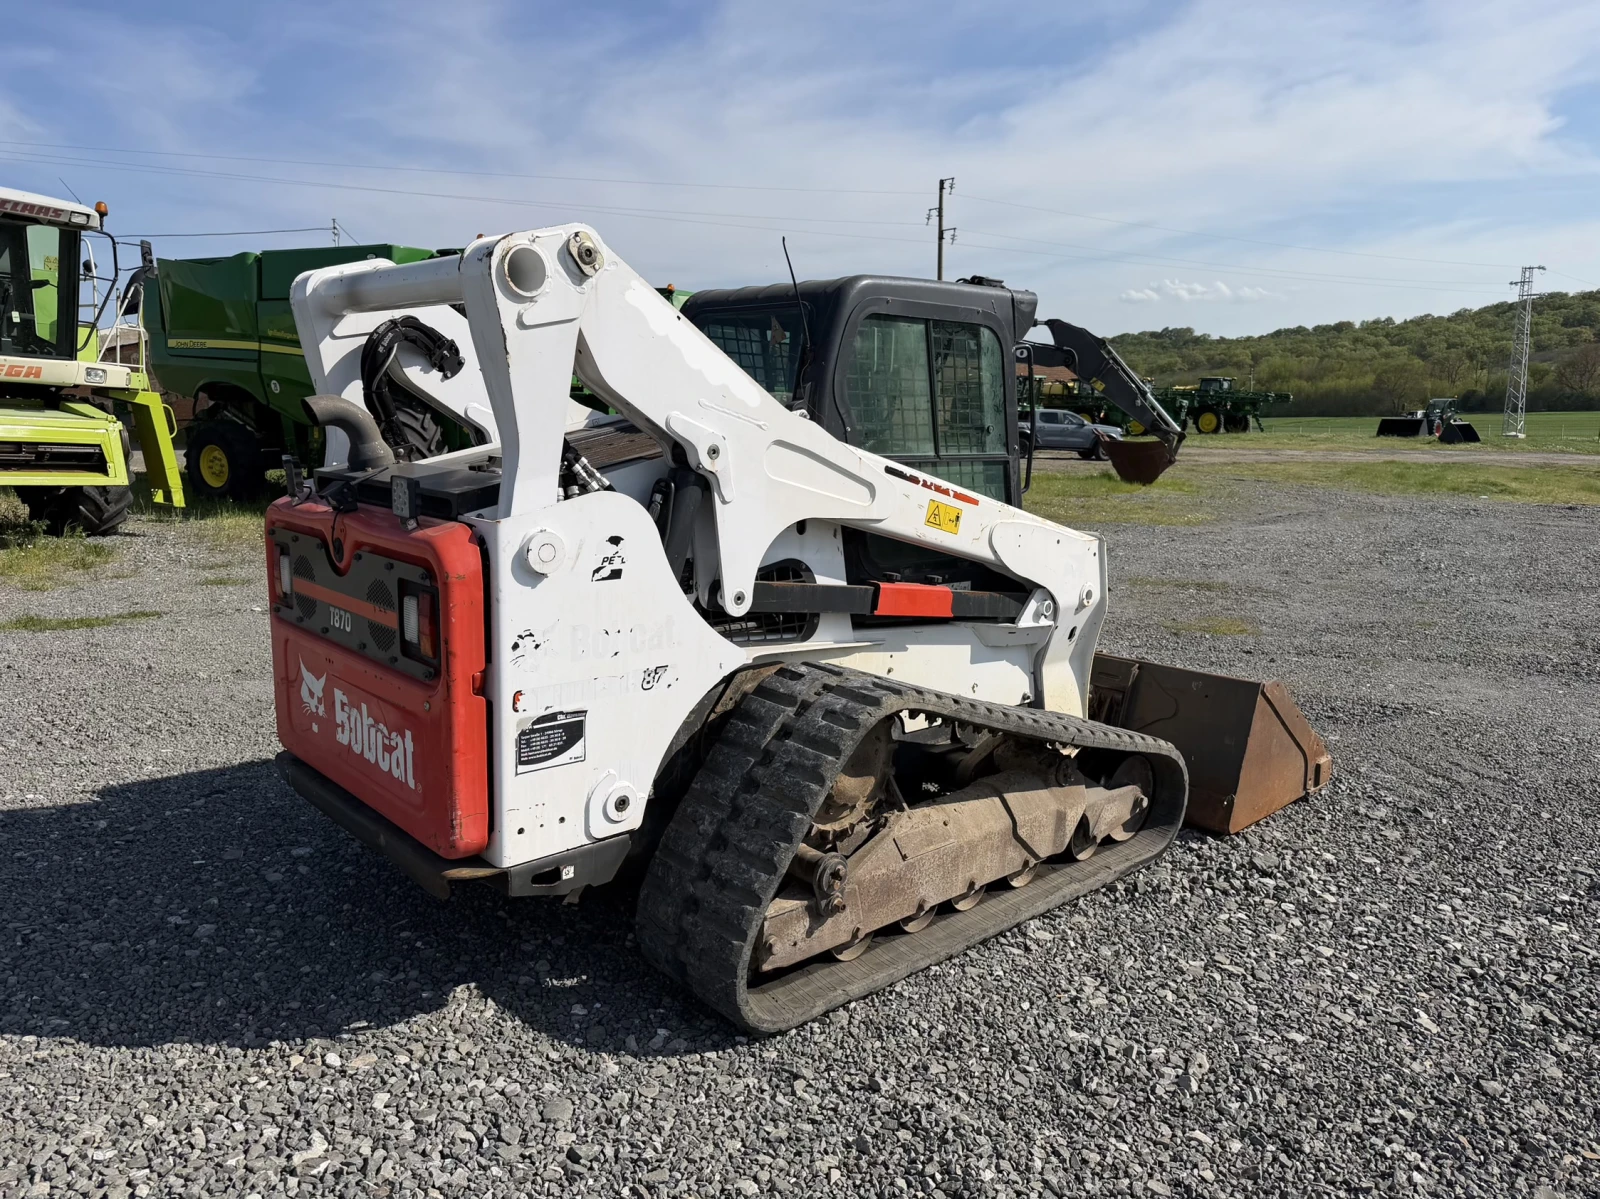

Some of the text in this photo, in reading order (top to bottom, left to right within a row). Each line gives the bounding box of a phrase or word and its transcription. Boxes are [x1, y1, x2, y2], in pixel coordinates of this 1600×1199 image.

[0, 200, 64, 219] CLAAS
[175, 340, 207, 348] JOHN DEERE
[329, 605, 352, 633] T870
[333, 687, 416, 790] Bobcat
